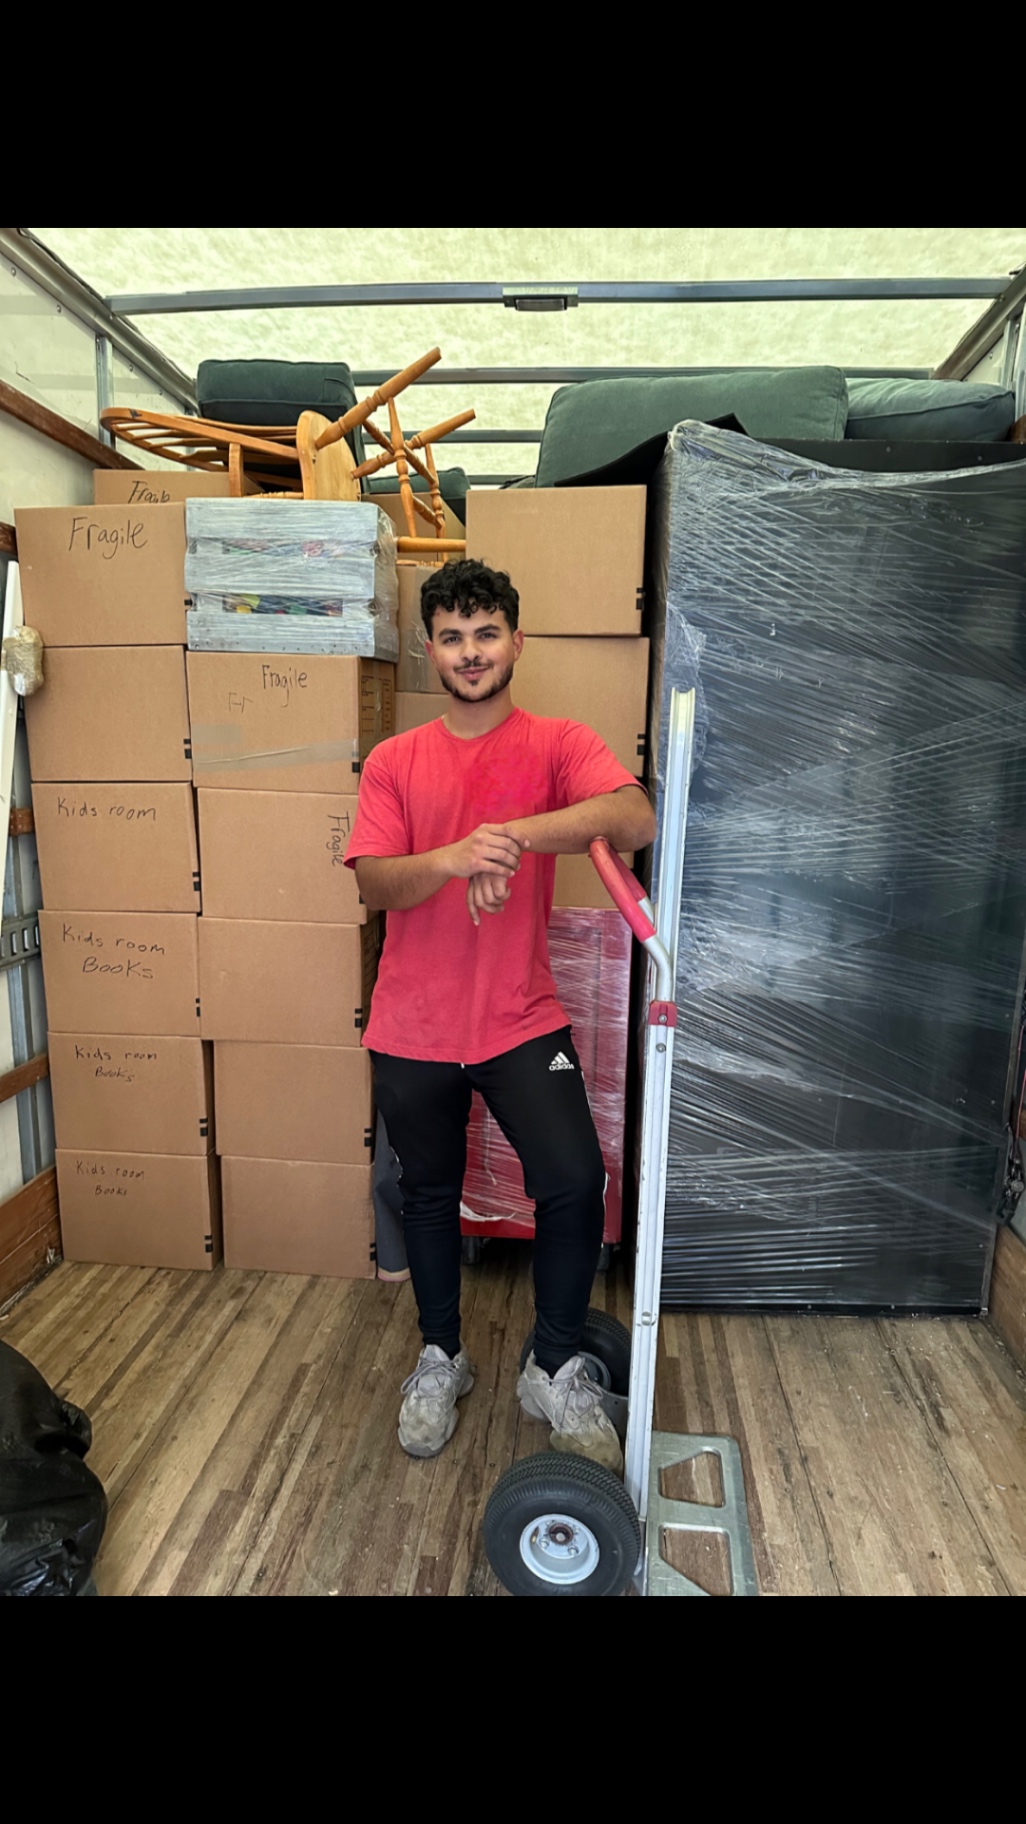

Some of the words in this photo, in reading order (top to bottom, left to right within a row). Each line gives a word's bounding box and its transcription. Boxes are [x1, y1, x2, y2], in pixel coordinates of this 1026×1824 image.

[68, 516, 148, 560] Fragile
[261, 664, 308, 708] Fragile
[57, 796, 98, 818] Kids
[109, 804, 157, 821] room
[325, 810, 351, 868] Fragile
[62, 923, 104, 948] Kids
[115, 937, 165, 956] room
[74, 1044, 112, 1062] Kids
[124, 1051, 158, 1061] room
[548, 1063, 575, 1071] adidas
[76, 1159, 106, 1176] Kids
[115, 1167, 145, 1180] room
